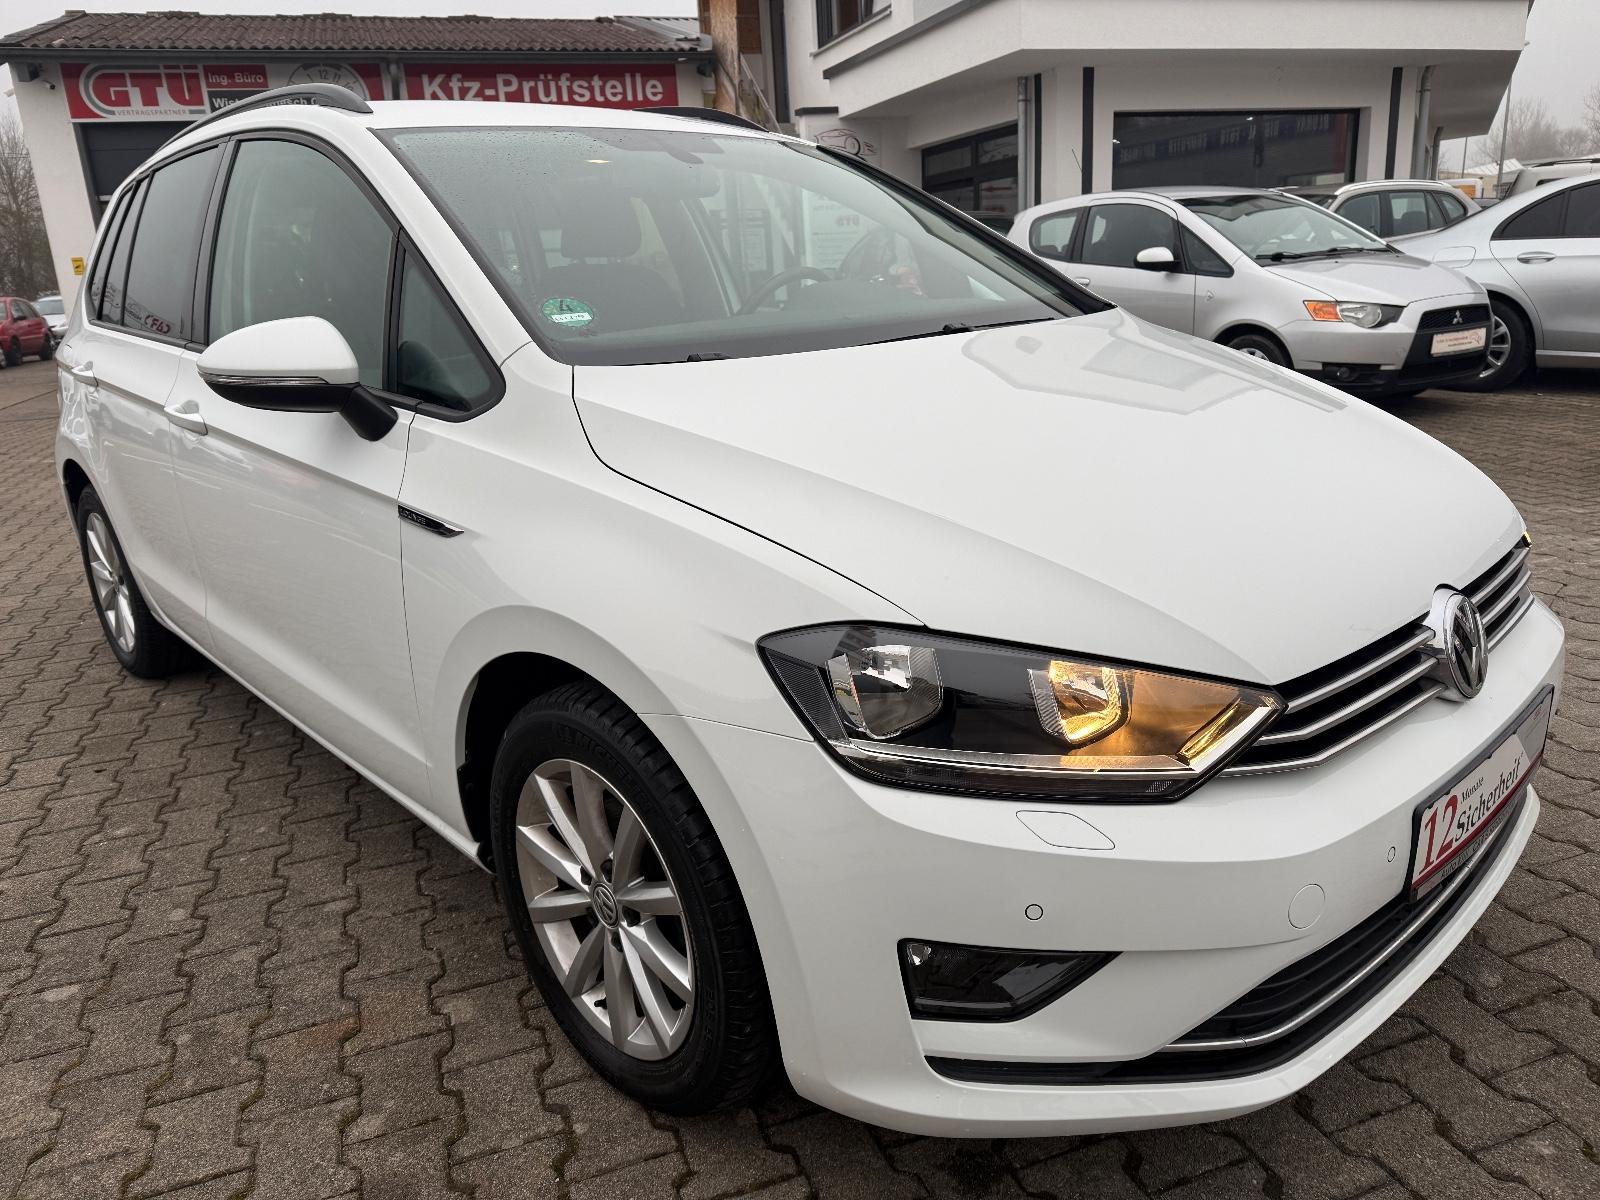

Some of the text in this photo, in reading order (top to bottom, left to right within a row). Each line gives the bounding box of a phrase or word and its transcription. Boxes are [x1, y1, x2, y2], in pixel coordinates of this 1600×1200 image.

[91, 64, 205, 107] GTÜ
[208, 71, 264, 86] Ing. Büro
[420, 73, 663, 103] Kfz-Prüfstelle
[117, 109, 187, 117] VERTRAGSPARTNER
[1455, 758, 1521, 843] Sicherheit
[1418, 794, 1458, 876] 12
